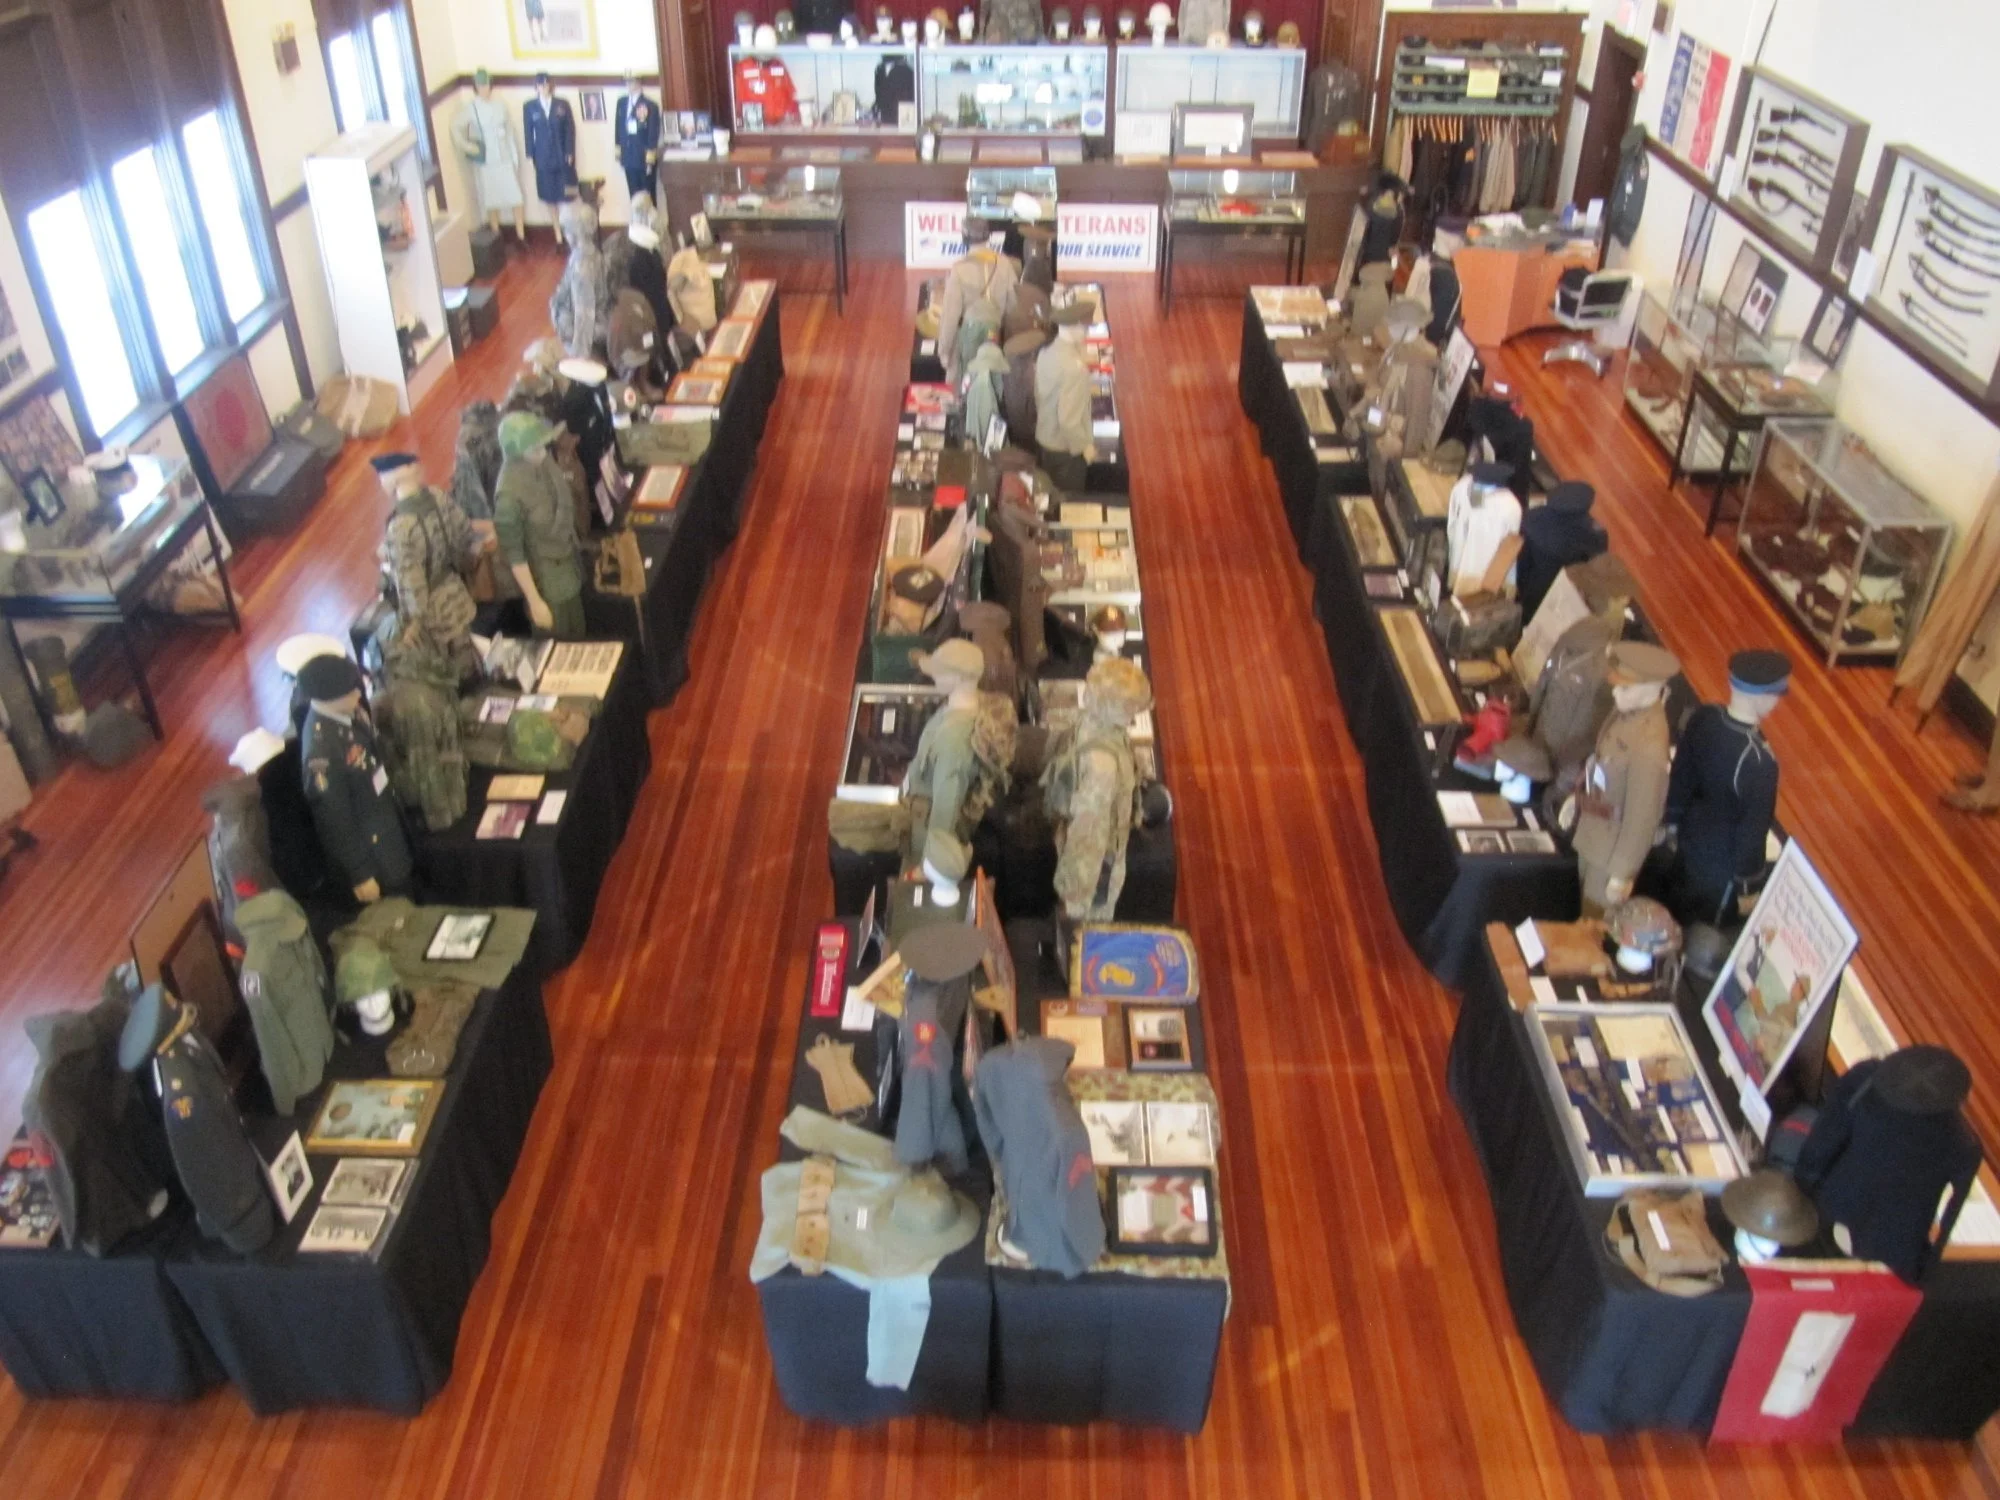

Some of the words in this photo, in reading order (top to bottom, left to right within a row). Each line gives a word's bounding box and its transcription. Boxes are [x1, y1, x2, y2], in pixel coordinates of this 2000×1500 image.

[1061, 215, 1146, 234] TERANS
[941, 242, 967, 256] THA
[1057, 243, 1083, 257] OUR
[1086, 243, 1143, 257] SERVICE
